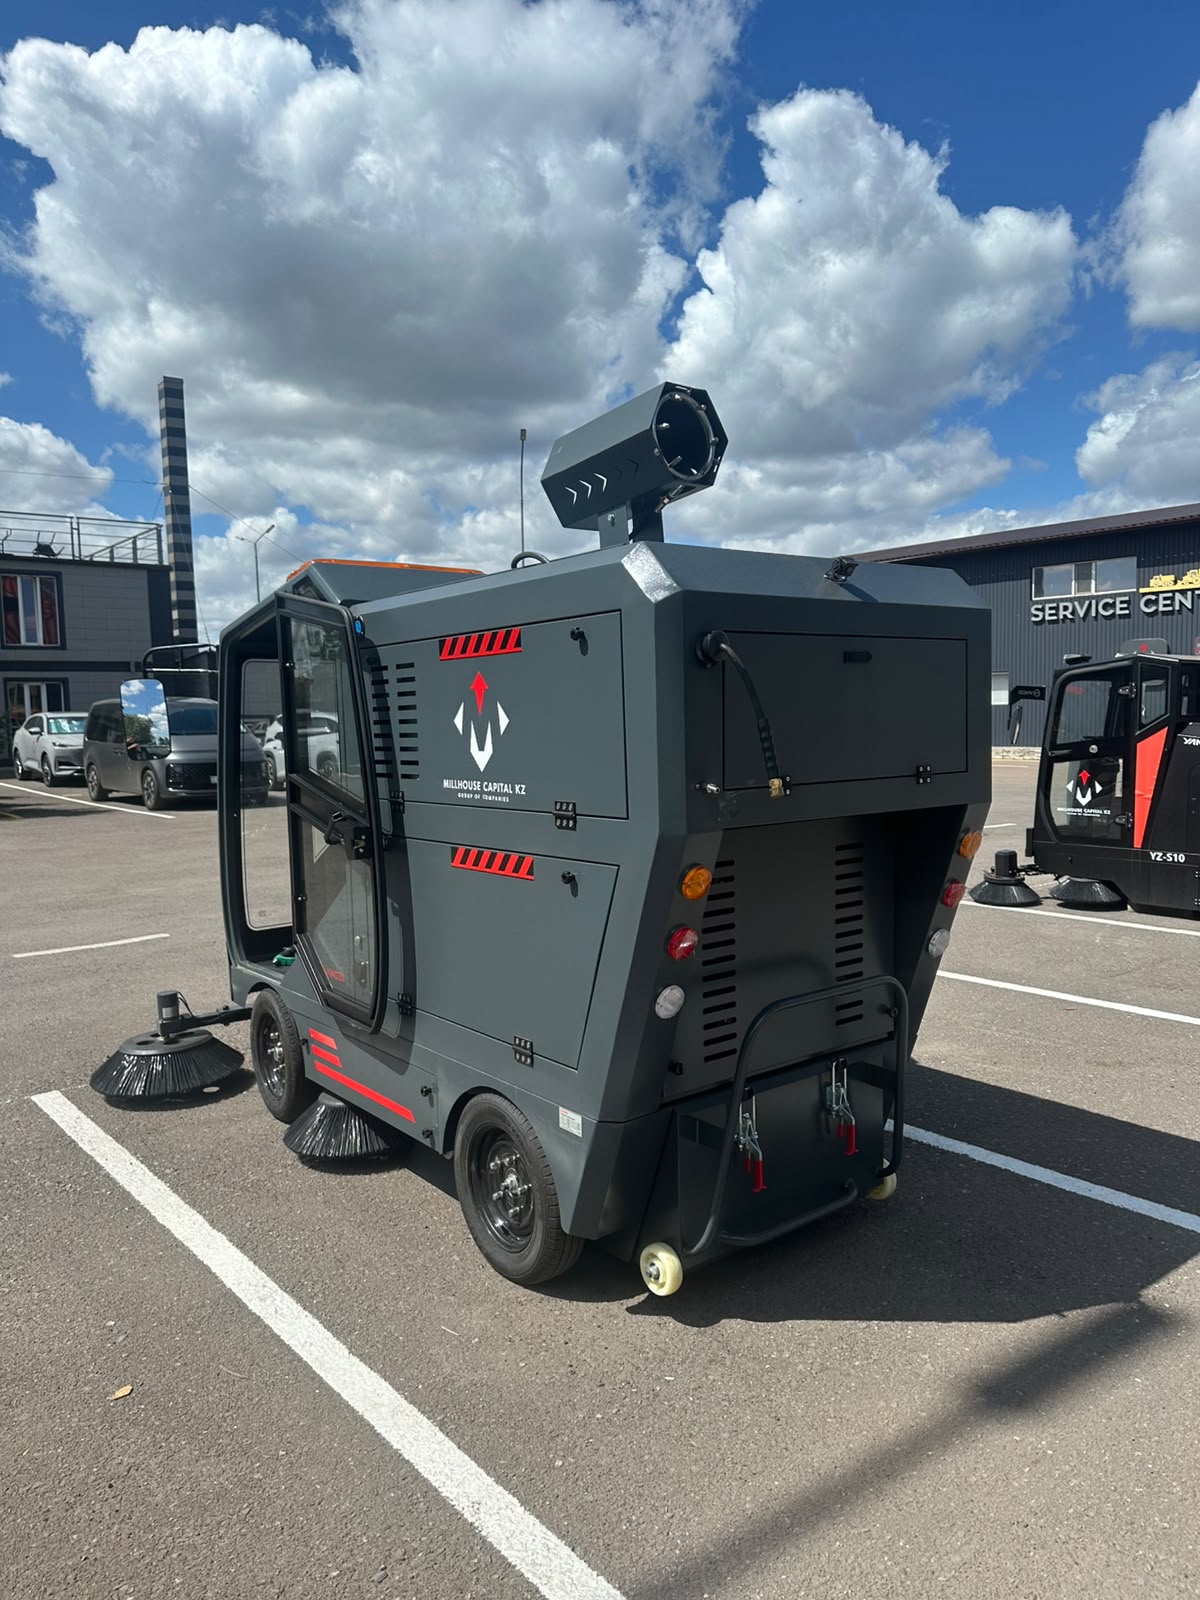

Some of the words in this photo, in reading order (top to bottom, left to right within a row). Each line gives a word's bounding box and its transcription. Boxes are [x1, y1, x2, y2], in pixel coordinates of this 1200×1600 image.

[1030, 596, 1130, 622] SERVICE
[443, 779, 481, 791] MILLHOUSE
[483, 781, 513, 794] CAPITAL
[515, 784, 526, 795] KZ
[482, 794, 509, 803] COMPANIES
[1150, 851, 1186, 863] YZ-S10
